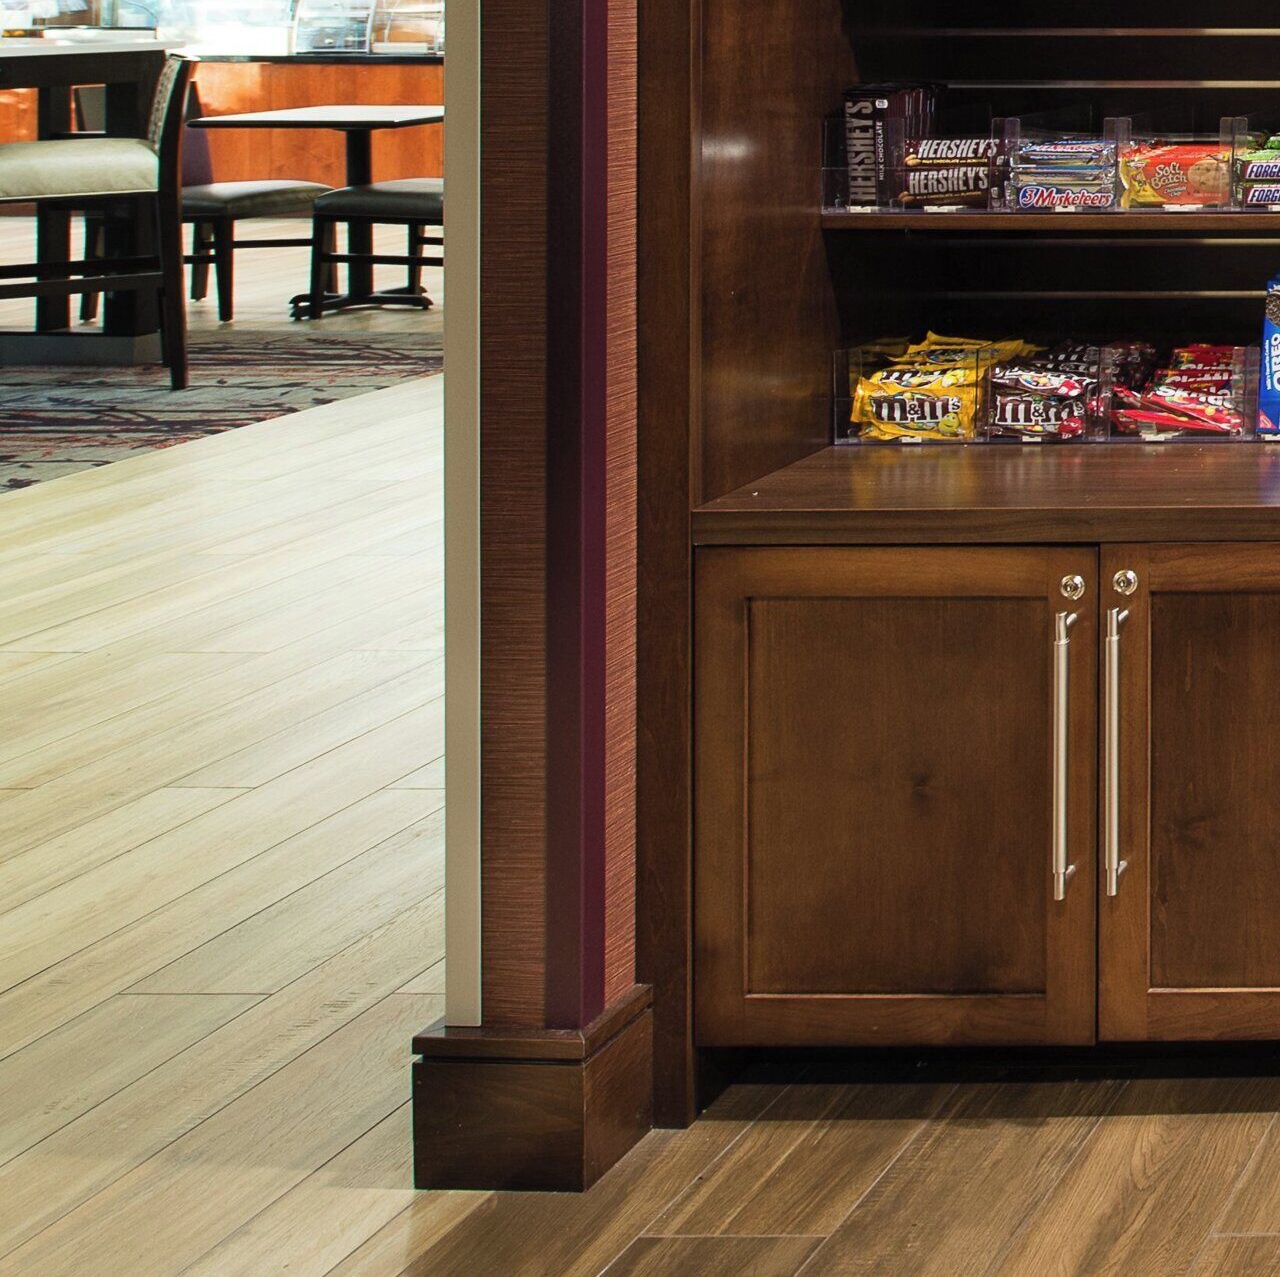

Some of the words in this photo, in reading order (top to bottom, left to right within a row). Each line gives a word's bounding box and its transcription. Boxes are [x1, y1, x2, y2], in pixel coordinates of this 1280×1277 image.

[846, 100, 878, 203] HERSHEY'S
[917, 138, 1000, 159] HERSHEY'S
[1156, 162, 1181, 178] Soft
[909, 166, 989, 195] HERSHEY'S
[1151, 173, 1188, 189] Batch
[1032, 189, 1113, 208] Musketeers
